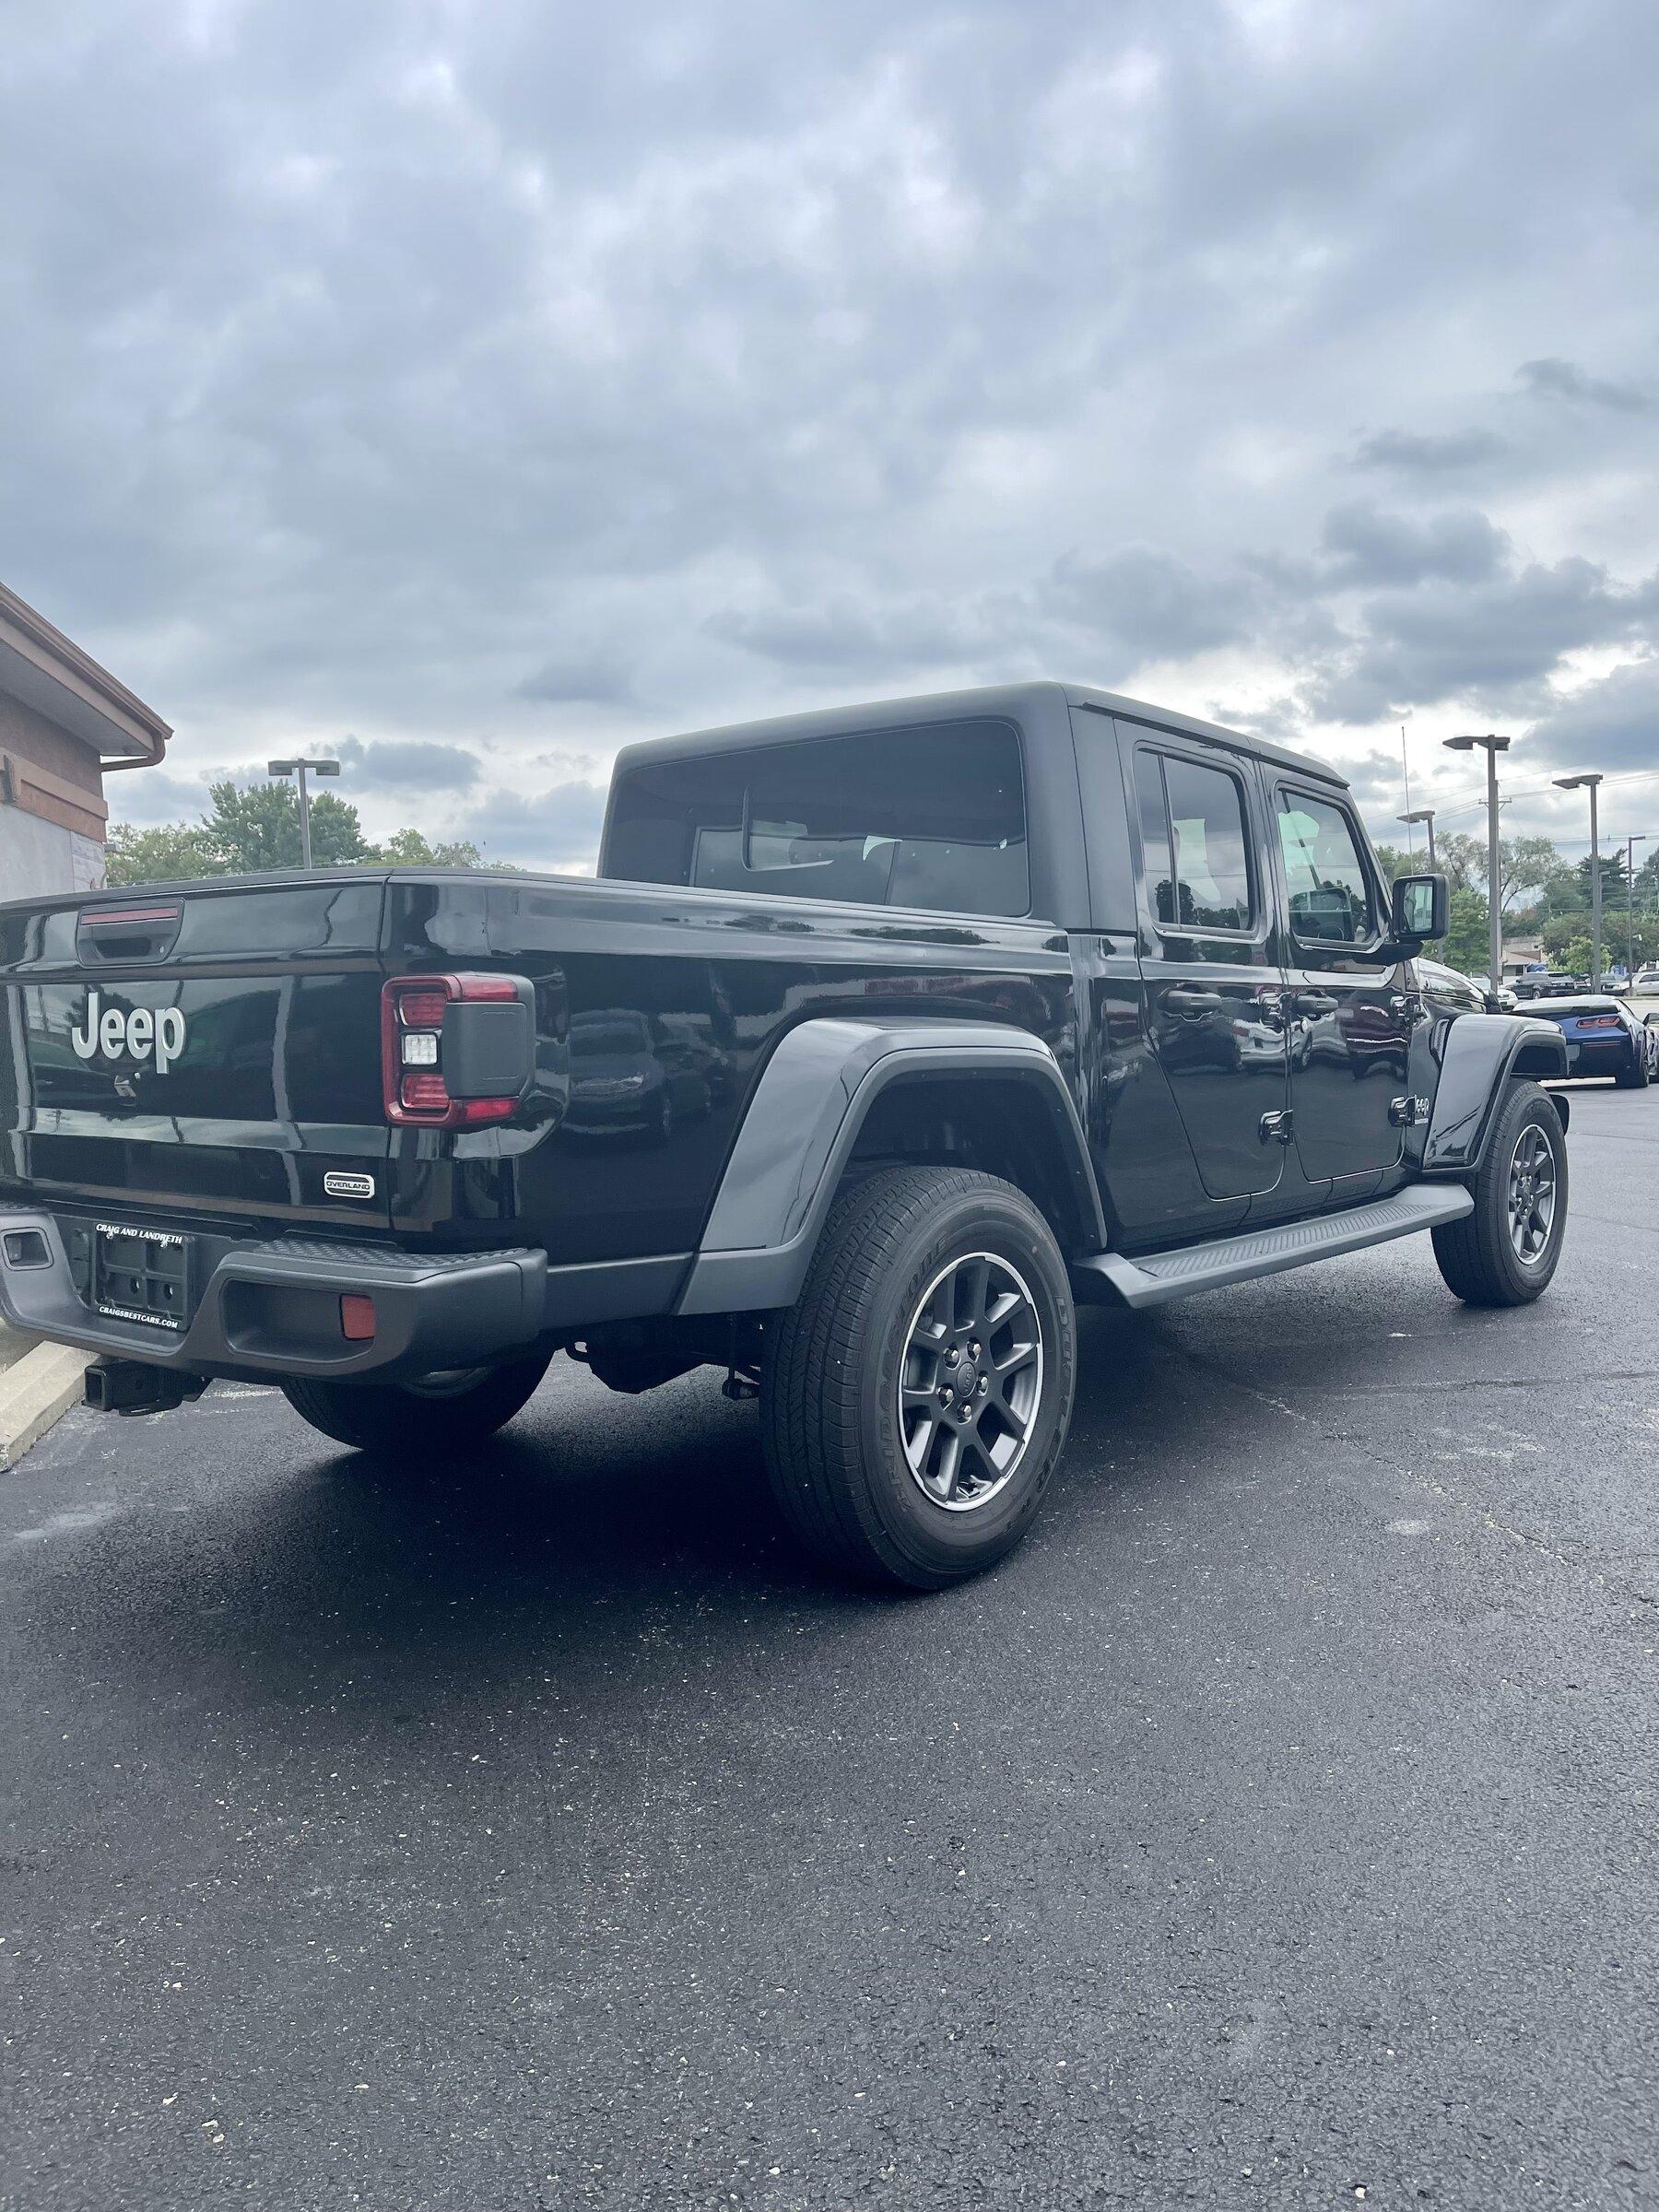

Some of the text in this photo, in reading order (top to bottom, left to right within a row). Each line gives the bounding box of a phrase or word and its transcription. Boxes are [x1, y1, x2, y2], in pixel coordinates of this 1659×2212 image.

[71, 992, 185, 1075] Jeep
[326, 1181, 371, 1190] OVERLAND
[96, 1223, 182, 1243] CRAIG AND LANDRETH
[99, 1306, 179, 1328] CRAIGSBESTCARS.COM
